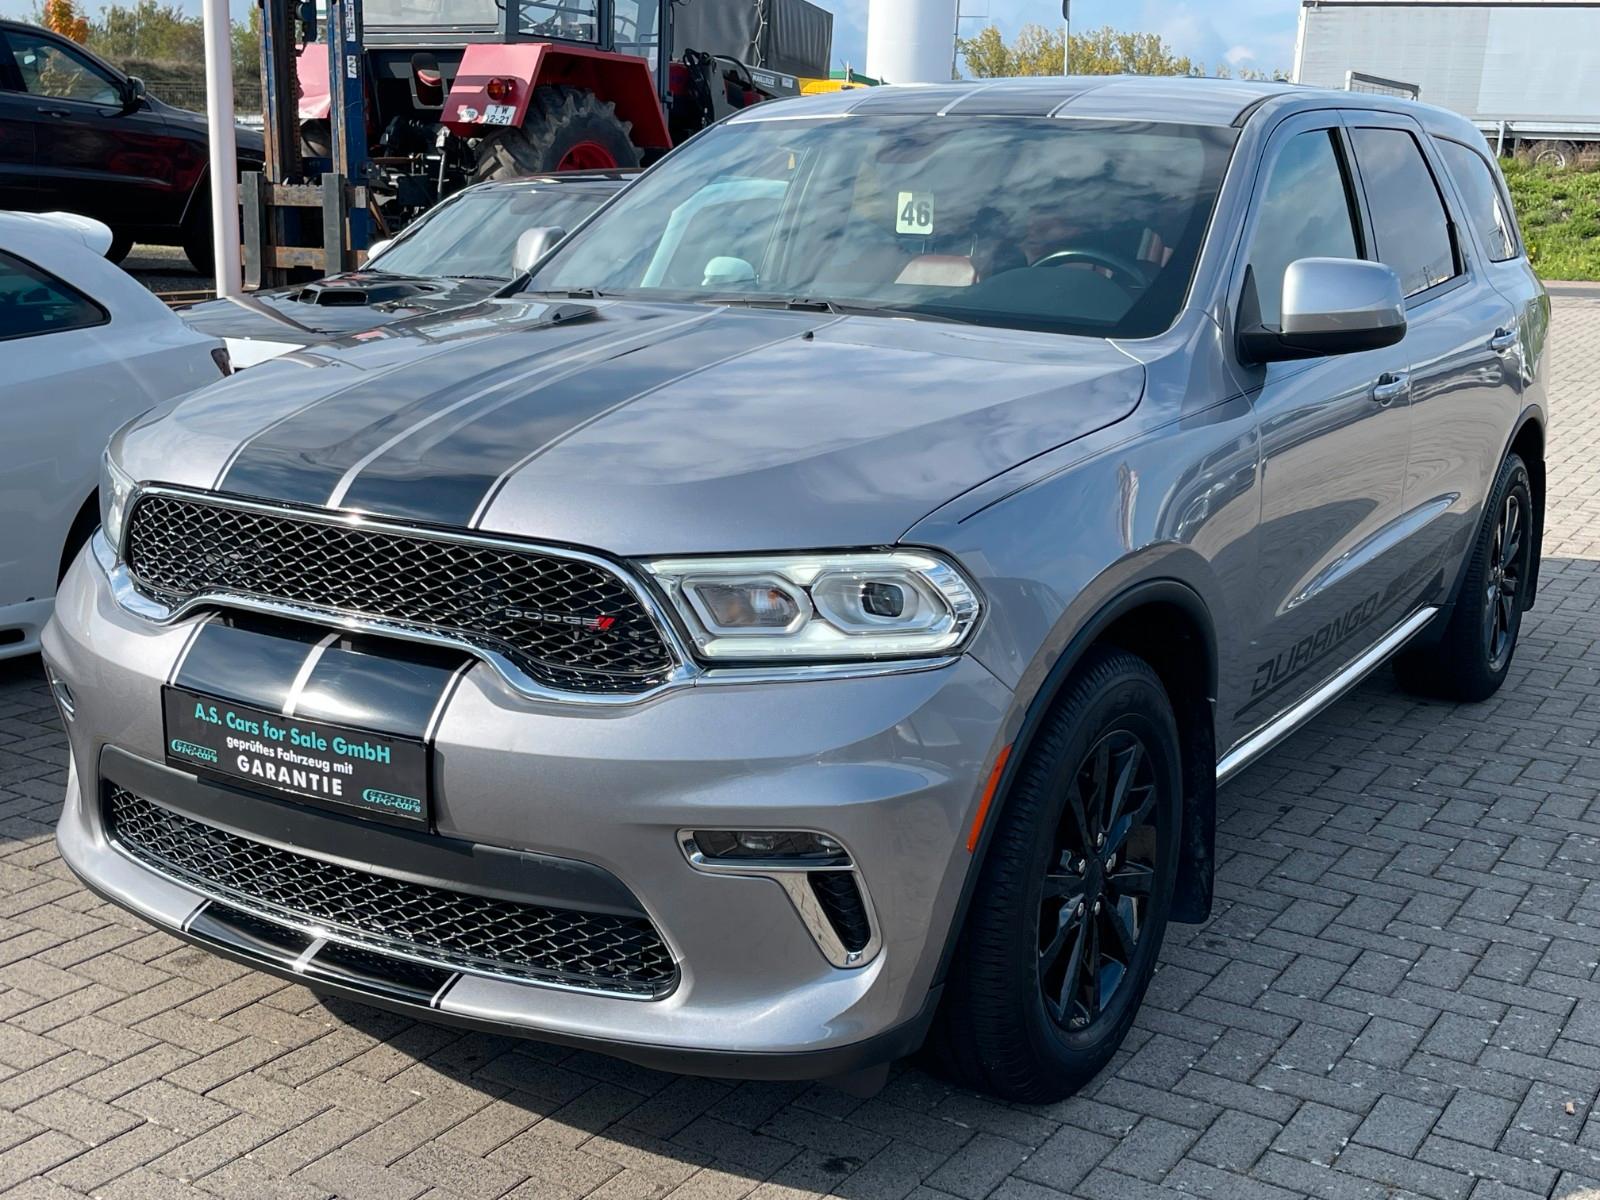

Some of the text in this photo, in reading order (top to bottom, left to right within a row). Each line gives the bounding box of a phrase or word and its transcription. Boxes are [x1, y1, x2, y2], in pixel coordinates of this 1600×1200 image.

[900, 200, 931, 228] 46
[505, 608, 600, 627] DODGE
[1251, 591, 1380, 696] DURANGO
[194, 703, 391, 764] A.S. Cars for Sale GmbH
[226, 735, 353, 775] geprüftes Fahrzeug mit
[236, 754, 343, 797] GARANTIE
